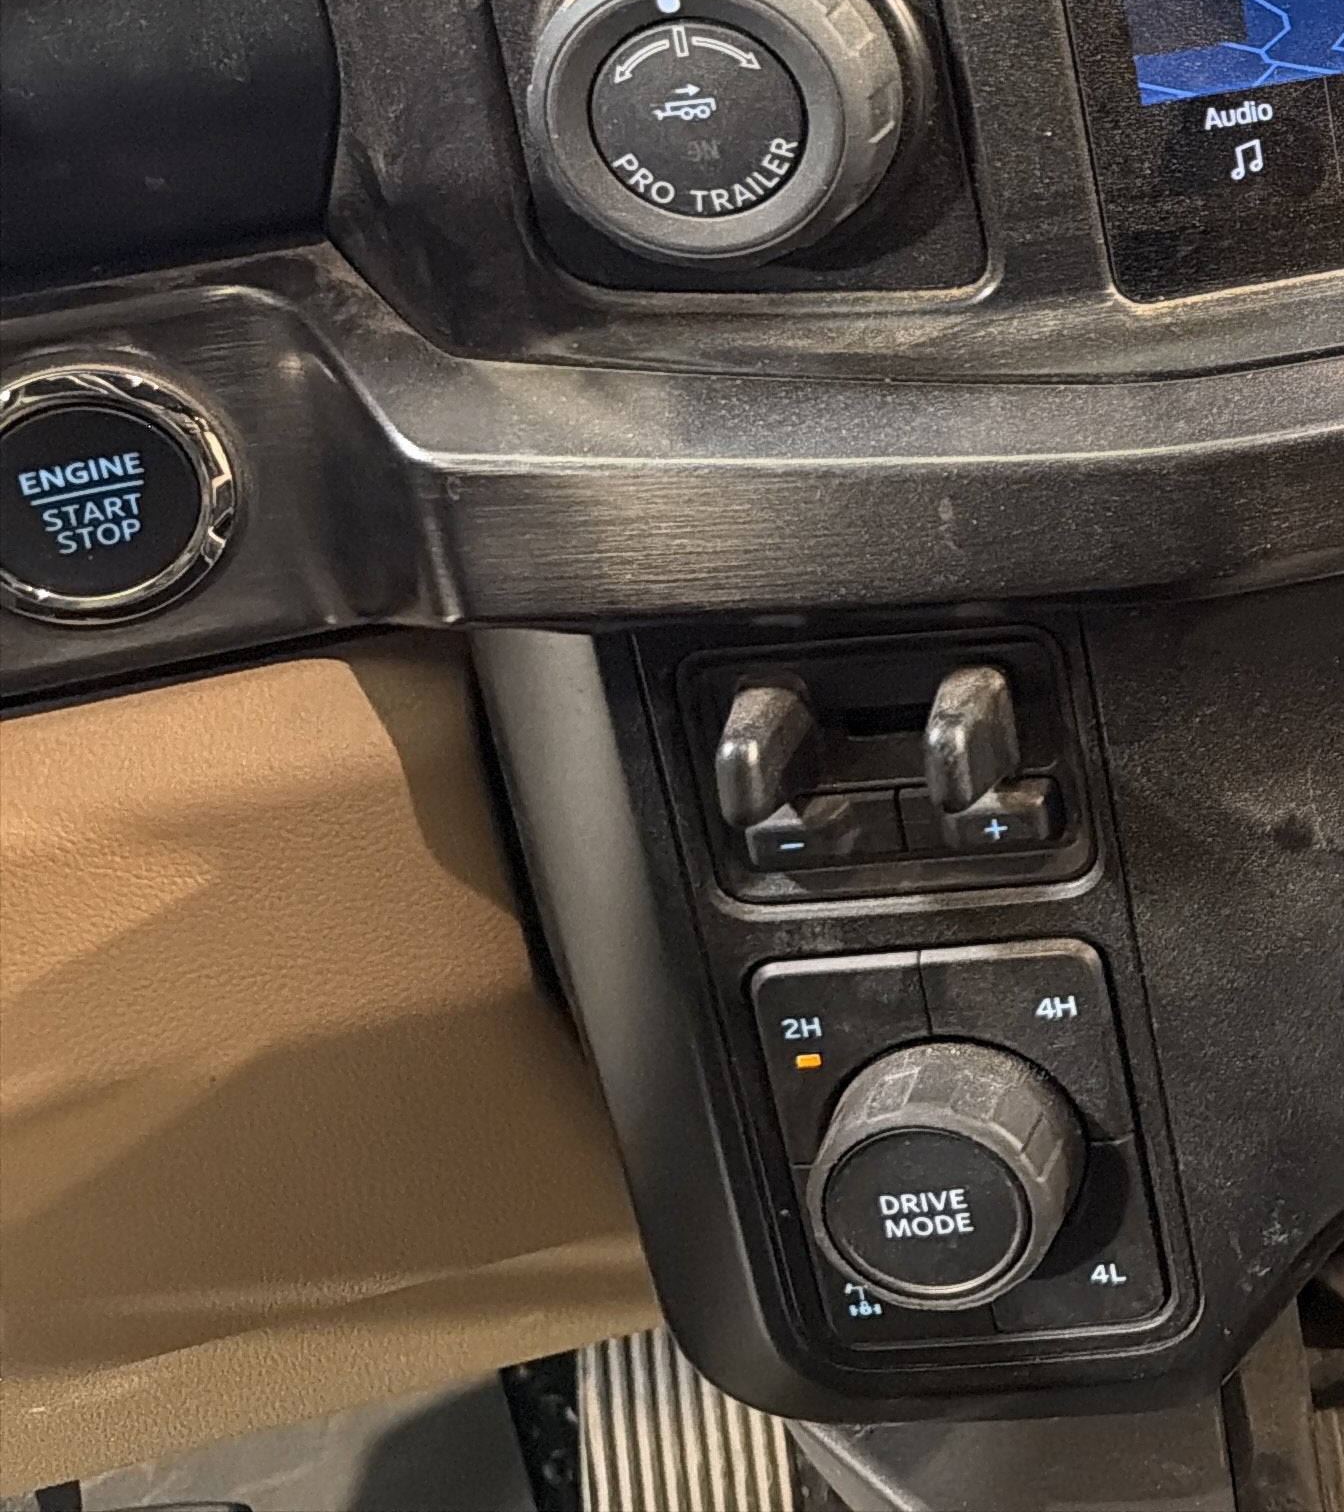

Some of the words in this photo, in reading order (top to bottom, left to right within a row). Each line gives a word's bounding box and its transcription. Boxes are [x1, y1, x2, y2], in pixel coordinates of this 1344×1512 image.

[1204, 99, 1274, 130] Audio
[612, 152, 676, 205] PRO
[689, 136, 799, 213] TRAILER
[17, 451, 145, 496] ENGINE
[42, 492, 142, 532] START
[56, 518, 142, 555] STOP
[1035, 994, 1079, 1020] 4H
[781, 1016, 823, 1040] 2H
[879, 1188, 969, 1216] DRIVE
[884, 1212, 975, 1238] MODE
[1090, 1263, 1127, 1286] 4L
